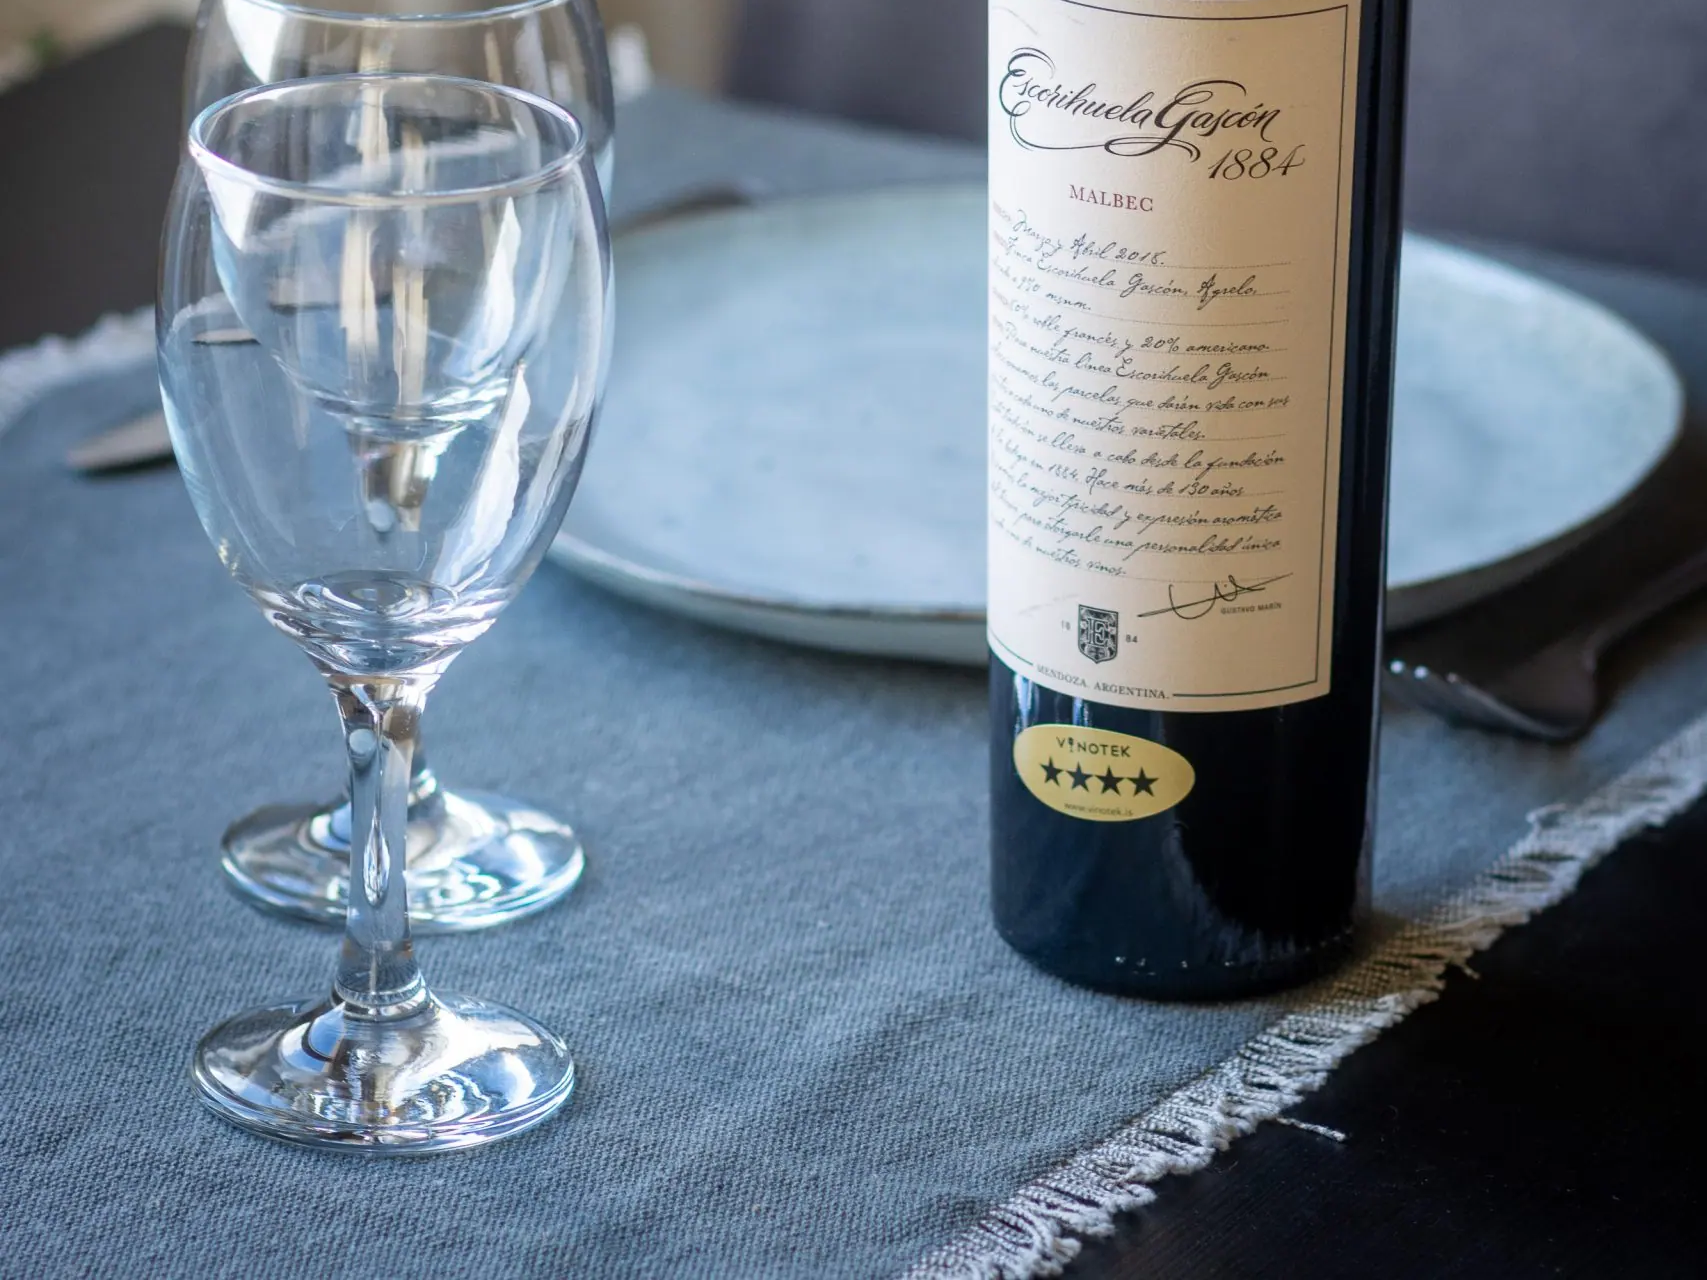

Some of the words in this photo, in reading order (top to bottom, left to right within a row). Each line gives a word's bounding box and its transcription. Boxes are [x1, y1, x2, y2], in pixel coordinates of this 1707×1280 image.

[1000, 47, 1153, 147] Escorihuela
[1130, 80, 1281, 158] Gascón
[1208, 144, 1306, 180] 1884
[1069, 184, 1153, 212] MALBEC
[1070, 233, 1117, 260] Abril
[1037, 251, 1116, 286] Escorihuela
[1114, 339, 1133, 359] y
[1140, 336, 1180, 354] 20%
[1115, 357, 1210, 383] Escorihuela
[1207, 362, 1270, 390] Gascón
[1115, 398, 1153, 415] que
[1205, 396, 1236, 411] vida
[1238, 401, 1264, 410] con
[1072, 416, 1125, 435] nuestros
[1107, 449, 1137, 465] cabo
[1140, 452, 1179, 468] desde
[1184, 449, 1204, 469] la
[1195, 450, 1285, 481] fundación
[1085, 467, 1120, 495] Hace
[1124, 478, 1152, 495] más
[1157, 481, 1175, 494] de
[1178, 481, 1210, 496] 130
[1210, 482, 1245, 496] años
[1113, 511, 1132, 530] y
[1104, 538, 1134, 547] una
[1220, 604, 1256, 615] GUSTAVO
[1056, 736, 1131, 758] VINOTEK
[1064, 803, 1134, 817] www.vinotek.is
